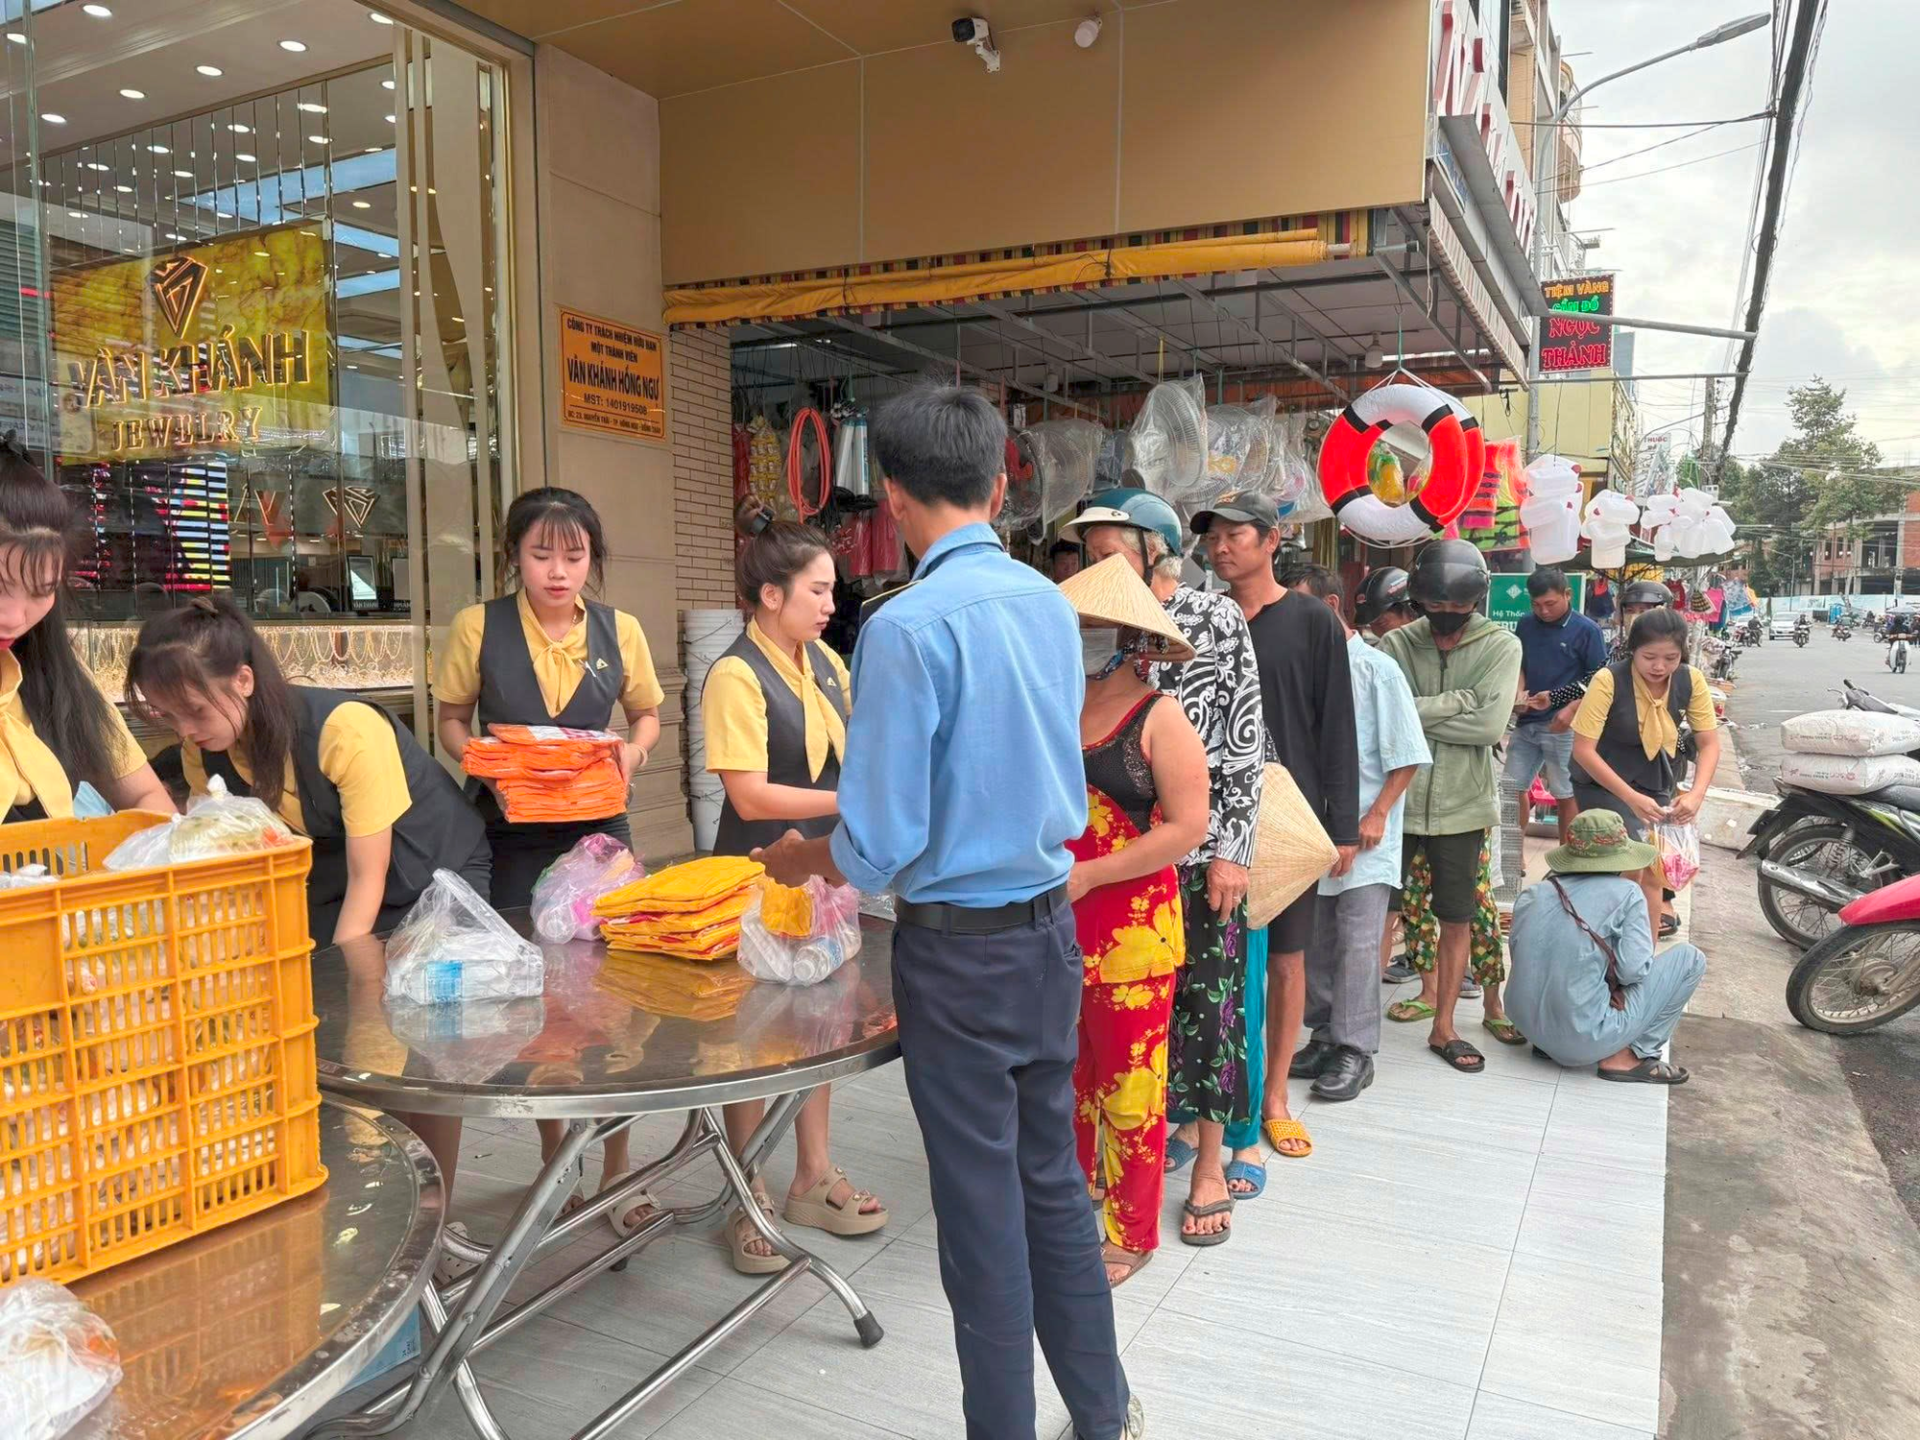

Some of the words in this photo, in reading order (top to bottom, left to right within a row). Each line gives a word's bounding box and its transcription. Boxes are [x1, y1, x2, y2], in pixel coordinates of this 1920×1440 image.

[1576, 280, 1610, 295] VÀNG
[587, 360, 617, 391] KHÁNH
[584, 393, 603, 406] MST:
[110, 405, 263, 451] JEWELRY
[1492, 610, 1504, 618] Hệ
